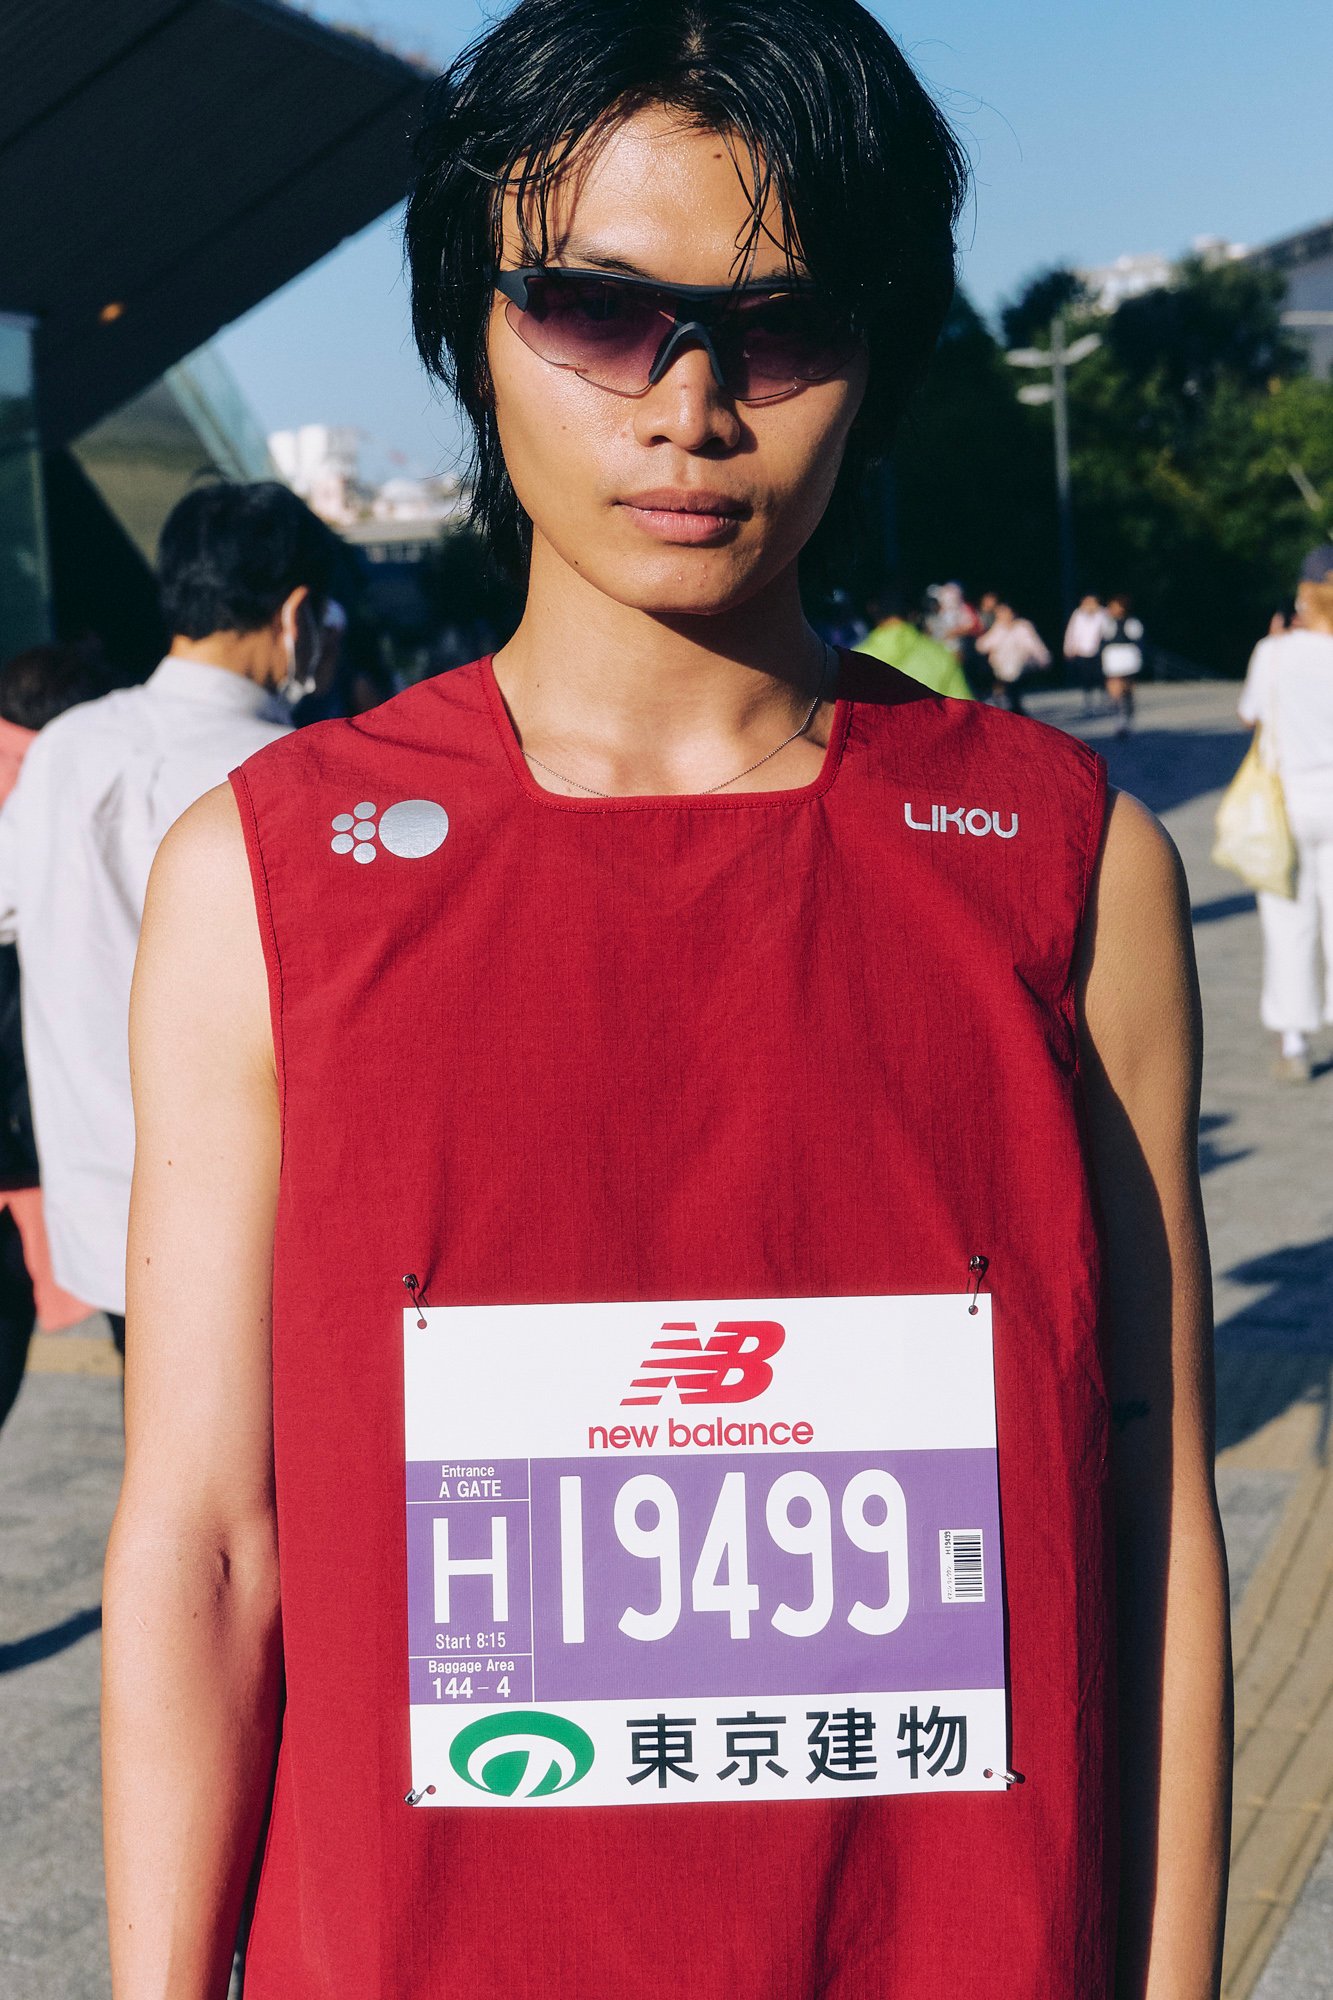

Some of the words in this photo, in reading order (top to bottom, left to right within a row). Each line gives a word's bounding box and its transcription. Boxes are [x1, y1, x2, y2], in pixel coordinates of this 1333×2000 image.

[904, 803, 1018, 838] LIKOU
[588, 1424, 658, 1449] new
[669, 1417, 814, 1447] balance
[442, 1465, 495, 1478] Entrance
[439, 1481, 450, 1498] A
[457, 1480, 502, 1497] GATE
[433, 1516, 508, 1624] H
[559, 1469, 910, 1643] 19499
[435, 1633, 471, 1649] Start
[477, 1632, 506, 1648] 8:15
[428, 1660, 482, 1674] Baggage
[487, 1659, 515, 1672] Area
[626, 1705, 967, 1788] 東京建物
